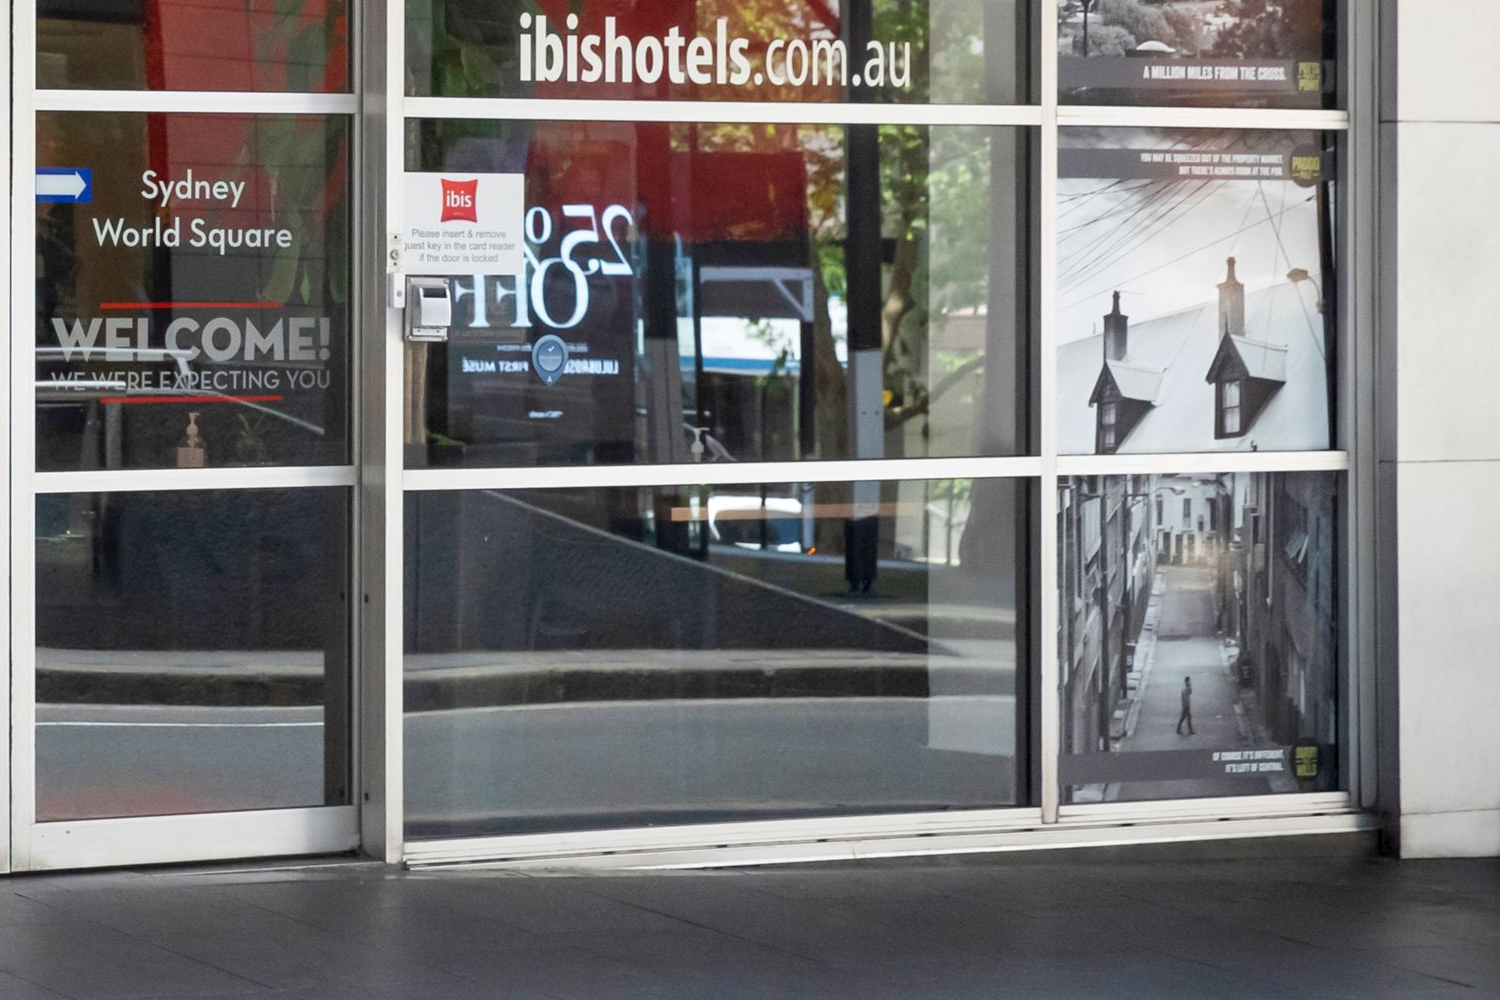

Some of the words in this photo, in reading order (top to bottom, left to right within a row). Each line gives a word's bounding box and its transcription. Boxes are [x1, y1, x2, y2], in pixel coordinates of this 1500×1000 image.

[519, 12, 911, 87] ibishotels.com.au
[1143, 65, 1149, 79] A
[1151, 65, 1185, 79] MILLION
[1187, 66, 1213, 80] MILES
[1214, 66, 1238, 80] FROM
[1240, 66, 1256, 80] THE
[141, 168, 246, 208] Sydney
[446, 190, 472, 207] ibis
[92, 217, 180, 248] World
[189, 218, 293, 256] Square
[411, 229, 440, 238] Please
[442, 229, 465, 238] insert
[467, 229, 473, 238] &
[427, 241, 442, 252] key
[444, 241, 451, 250] in
[453, 241, 466, 250] the
[469, 242, 487, 250] card
[489, 242, 515, 250] reader
[420, 253, 425, 262] if
[427, 253, 440, 262] the
[442, 254, 460, 262] door
[463, 254, 470, 262] is
[471, 254, 499, 262] locked
[51, 316, 331, 362] WELCOME!
[51, 372, 85, 391] WE
[92, 372, 152, 391] WERE
[159, 370, 280, 390] EXPECTING
[286, 370, 330, 389] YOU
